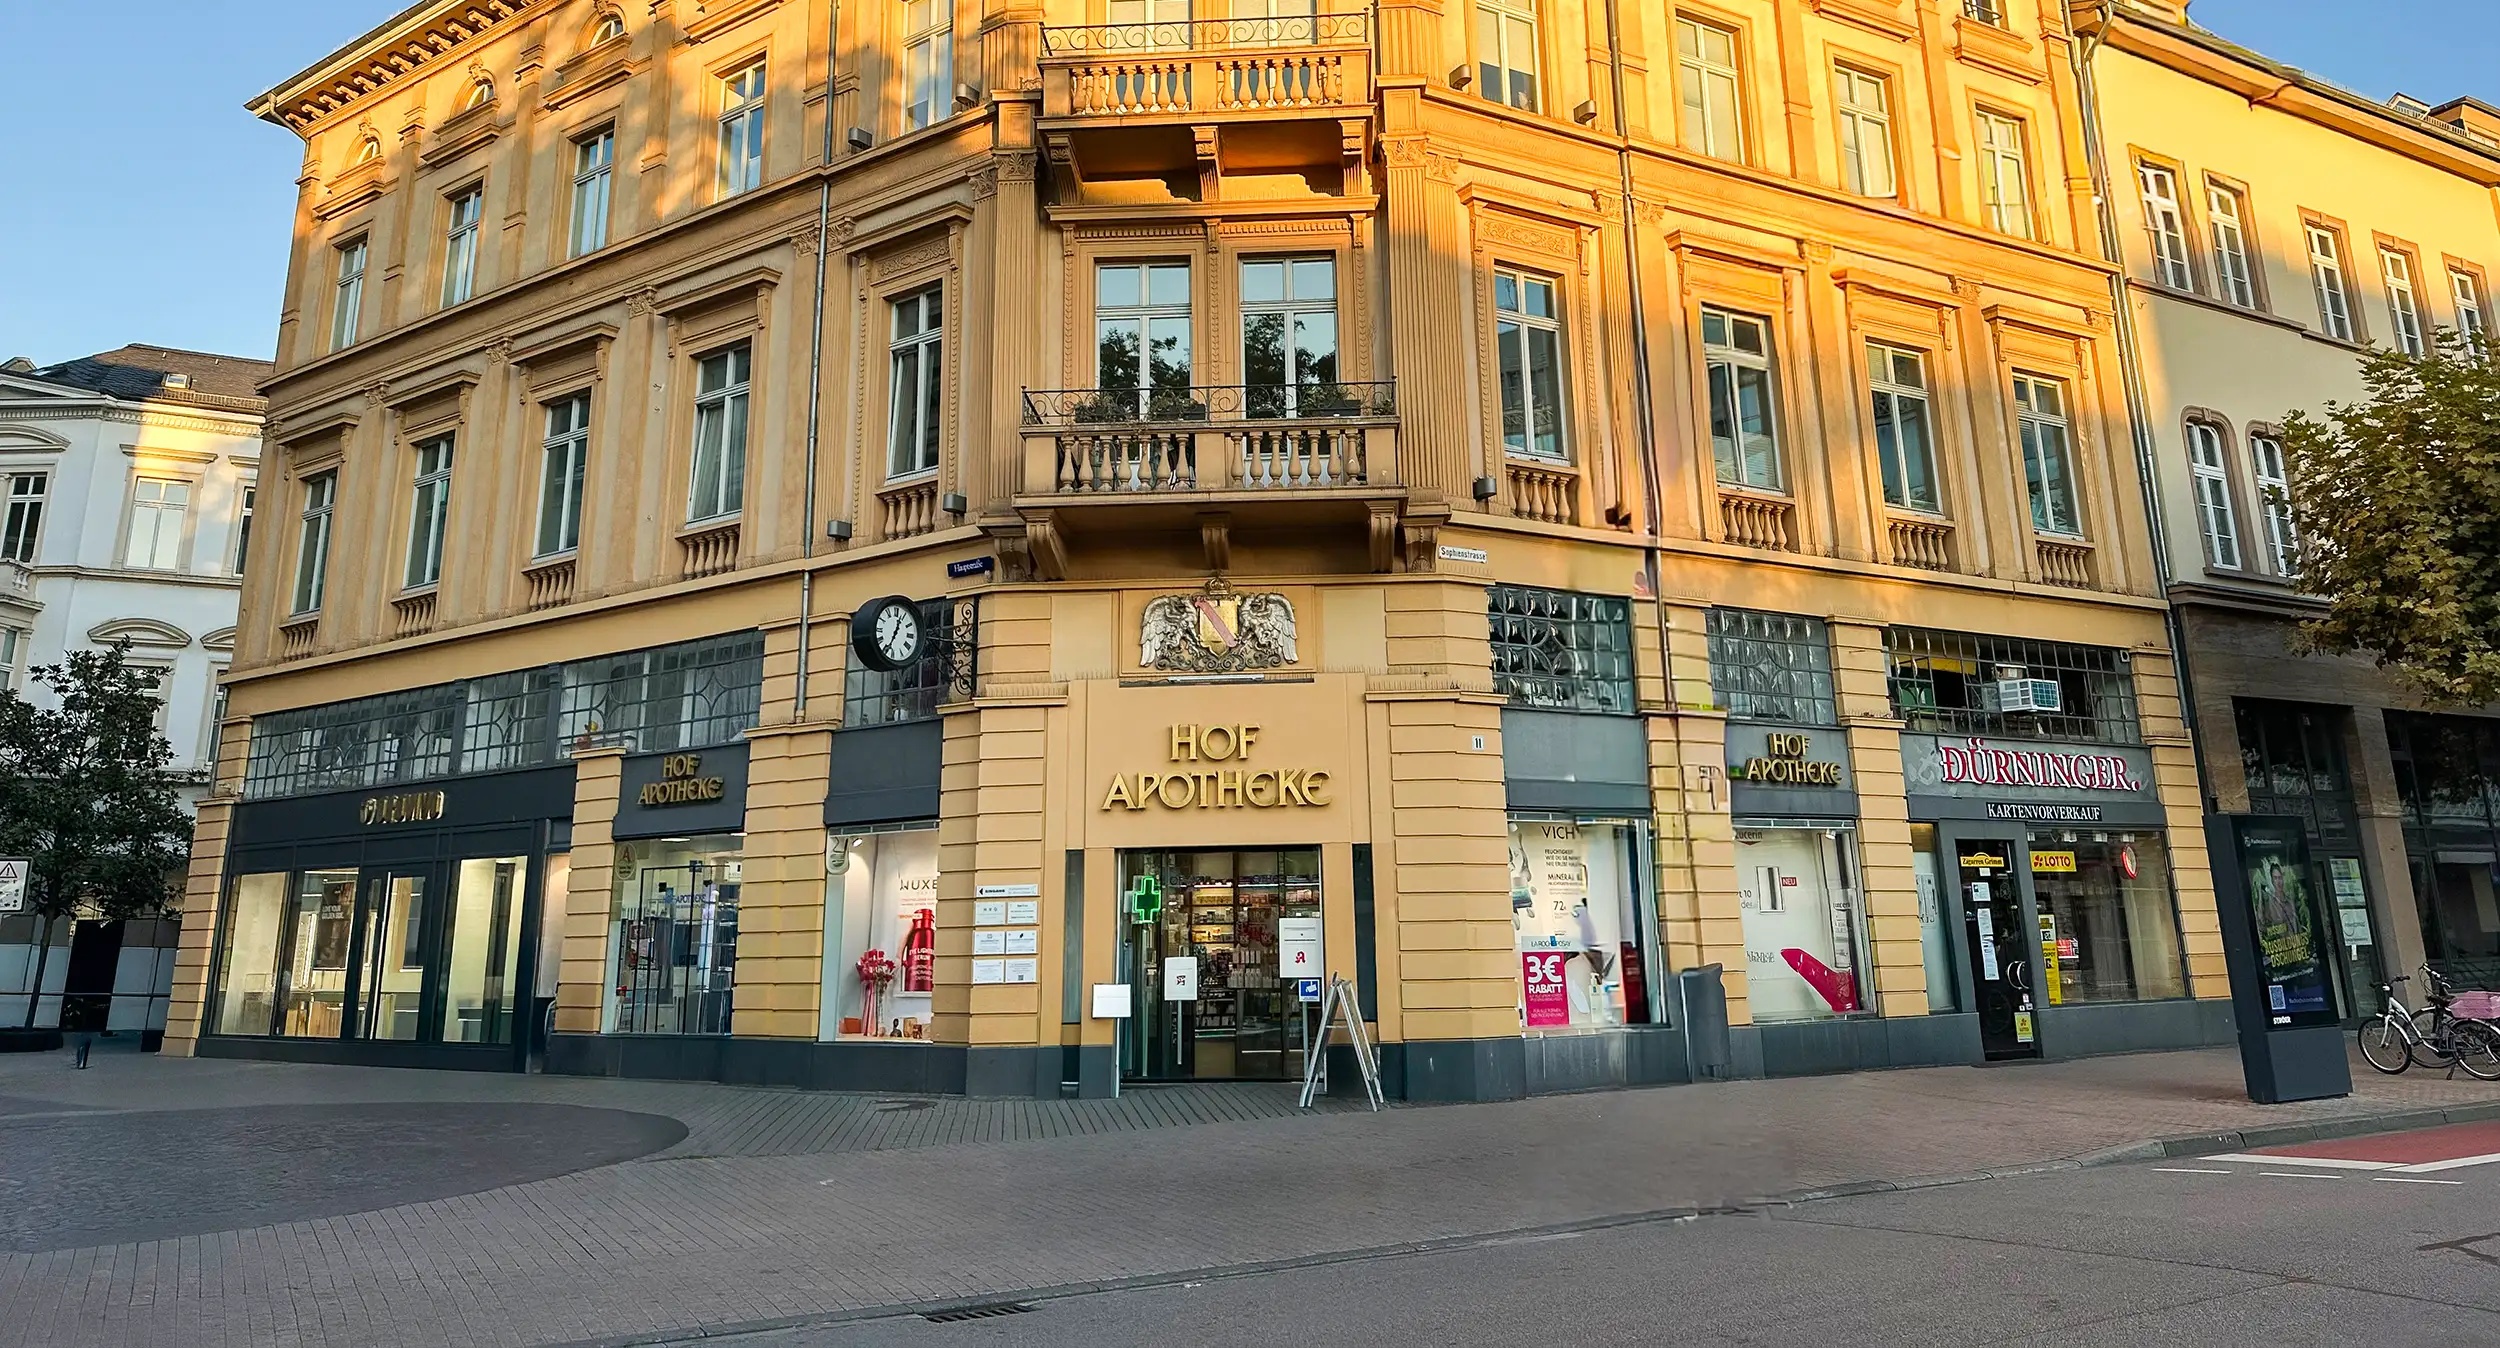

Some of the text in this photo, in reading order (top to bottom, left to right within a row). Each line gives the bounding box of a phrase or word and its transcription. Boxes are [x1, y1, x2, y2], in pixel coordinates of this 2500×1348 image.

[1440, 547, 1486, 560] Sophienstrasse
[1169, 723, 1260, 761] HOF
[1475, 737, 1482, 748] 11
[1768, 733, 1810, 756] HOF
[663, 754, 701, 777] HOF
[1746, 758, 1842, 784] APOTHEKE
[637, 777, 724, 805] APOTHEKE
[1101, 769, 1332, 810] APOTHEKE
[1987, 804, 2100, 820] KARTENVORVERKAUF
[2044, 857, 2071, 867] LOTTO
[676, 894, 706, 903] APOTEKE
[1526, 955, 1562, 983] 3€
[1528, 984, 1563, 994] RABATT
